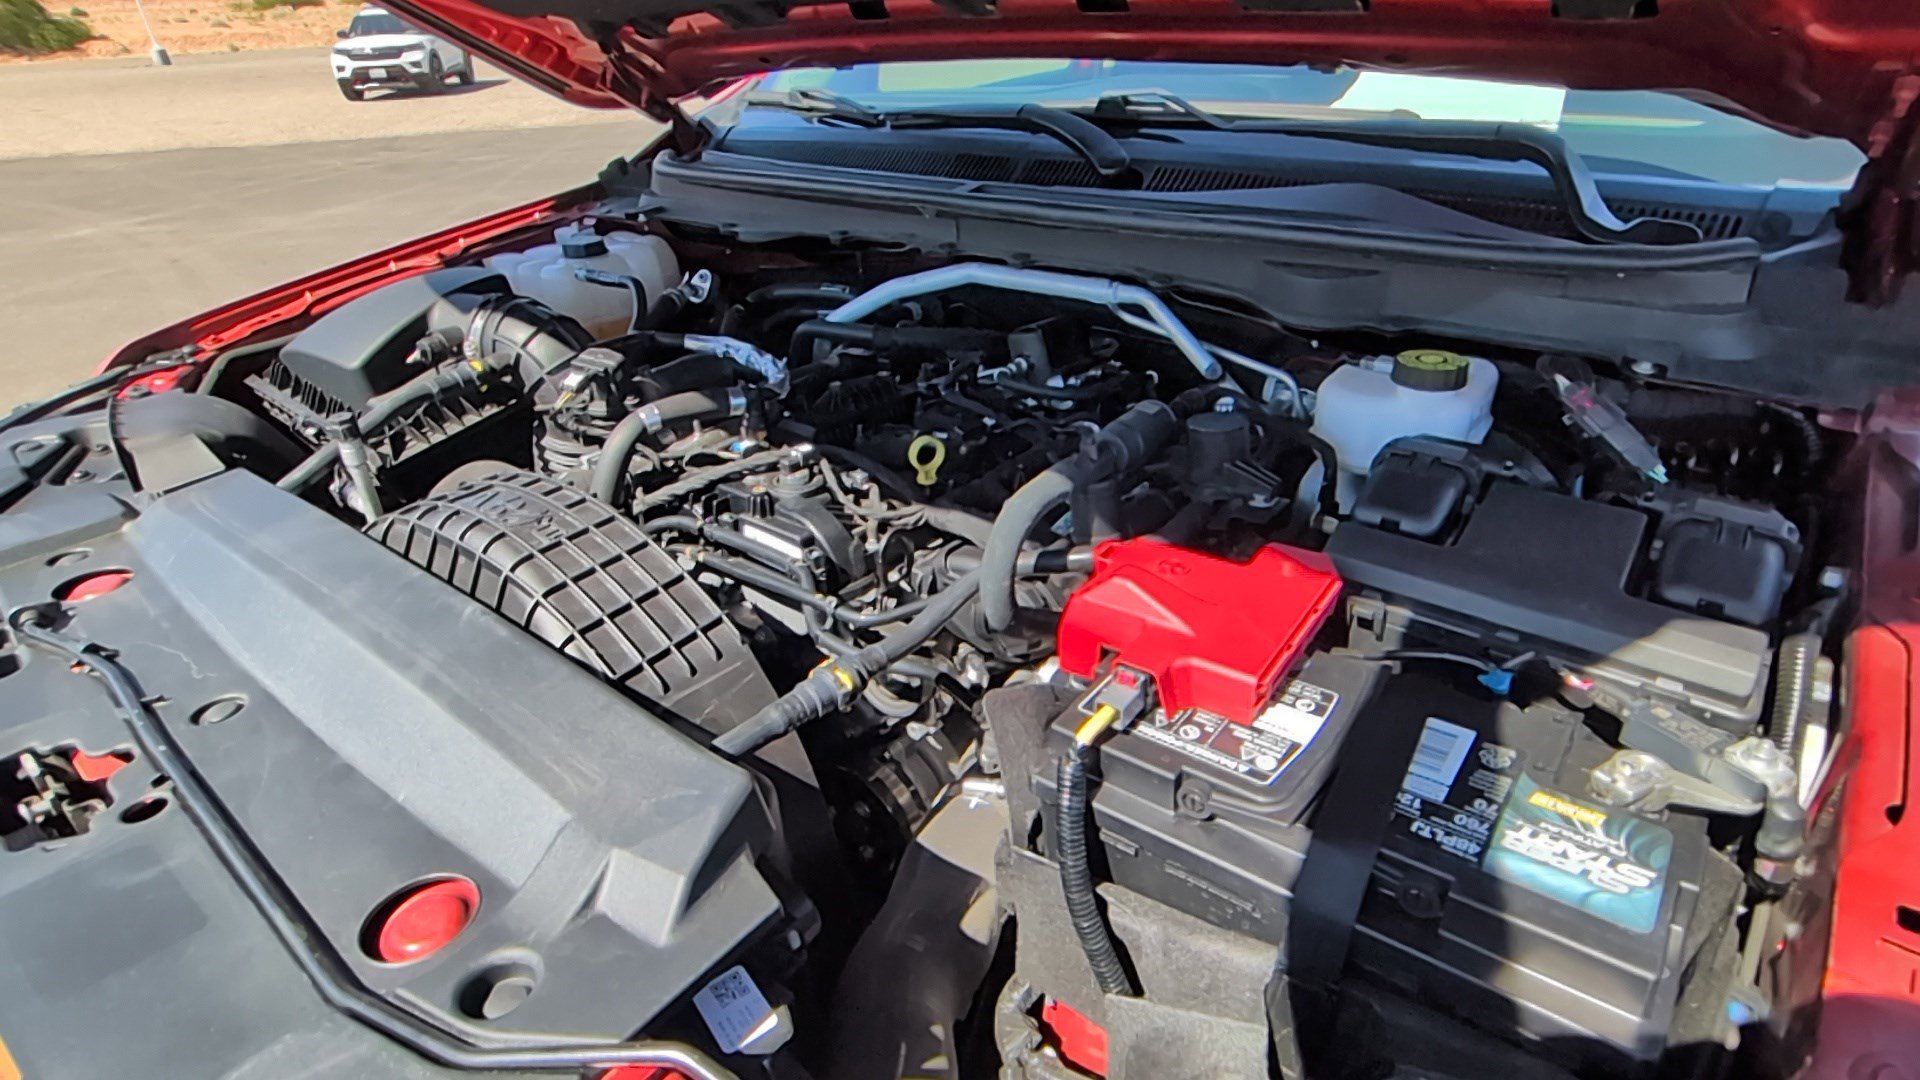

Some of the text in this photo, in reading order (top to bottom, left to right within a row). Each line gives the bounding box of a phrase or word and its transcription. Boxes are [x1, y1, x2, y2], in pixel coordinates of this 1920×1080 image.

[1454, 815, 1490, 835] 760
[1502, 832, 1631, 894] SUPER
[1506, 826, 1658, 888] START
